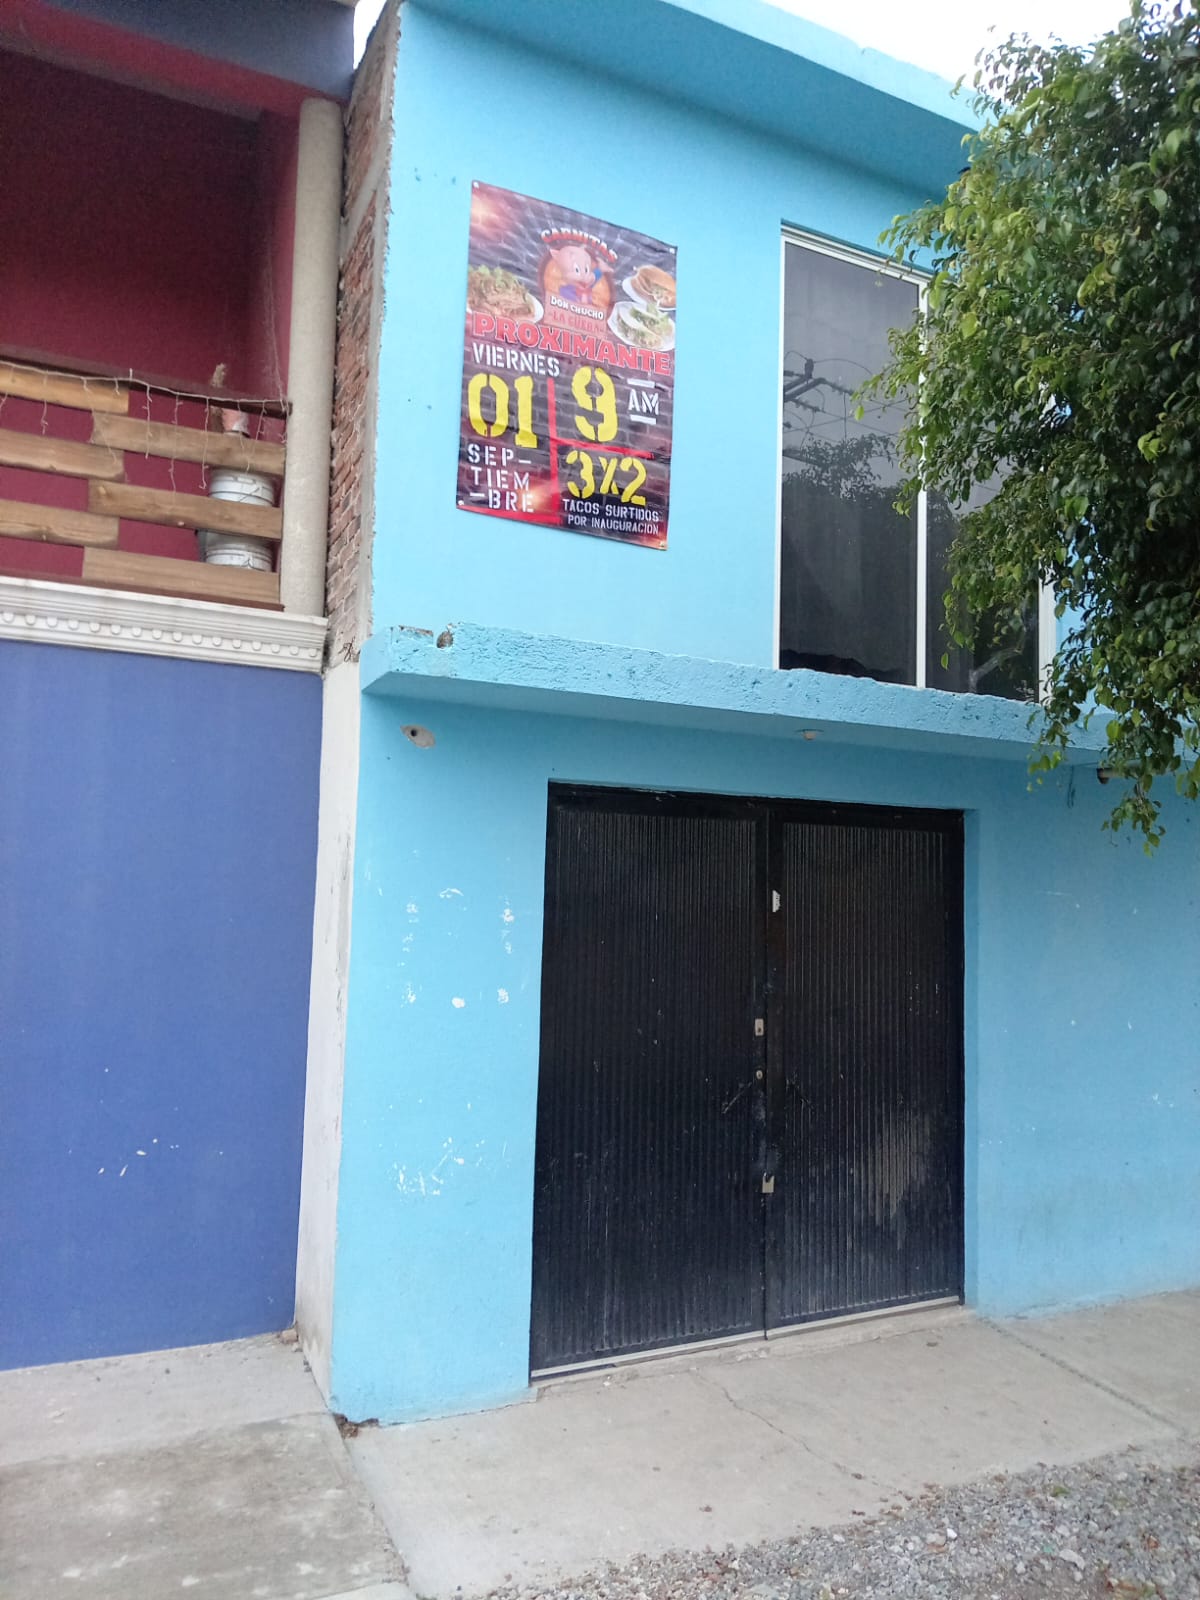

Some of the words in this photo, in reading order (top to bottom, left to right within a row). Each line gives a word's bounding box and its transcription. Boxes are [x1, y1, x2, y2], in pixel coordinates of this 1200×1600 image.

[551, 296, 569, 310] DON
[570, 304, 605, 320] CHUCHO
[553, 311, 566, 325] LA
[472, 311, 671, 376] PROXIMANTE
[472, 342, 560, 377] VIERNES
[468, 373, 538, 448] 01
[571, 366, 618, 442] 9
[628, 389, 659, 415] AM
[470, 466, 530, 492] TIEM
[563, 499, 600, 515] TACOS
[605, 504, 660, 522] SURTIDOS
[568, 514, 587, 527] POR
